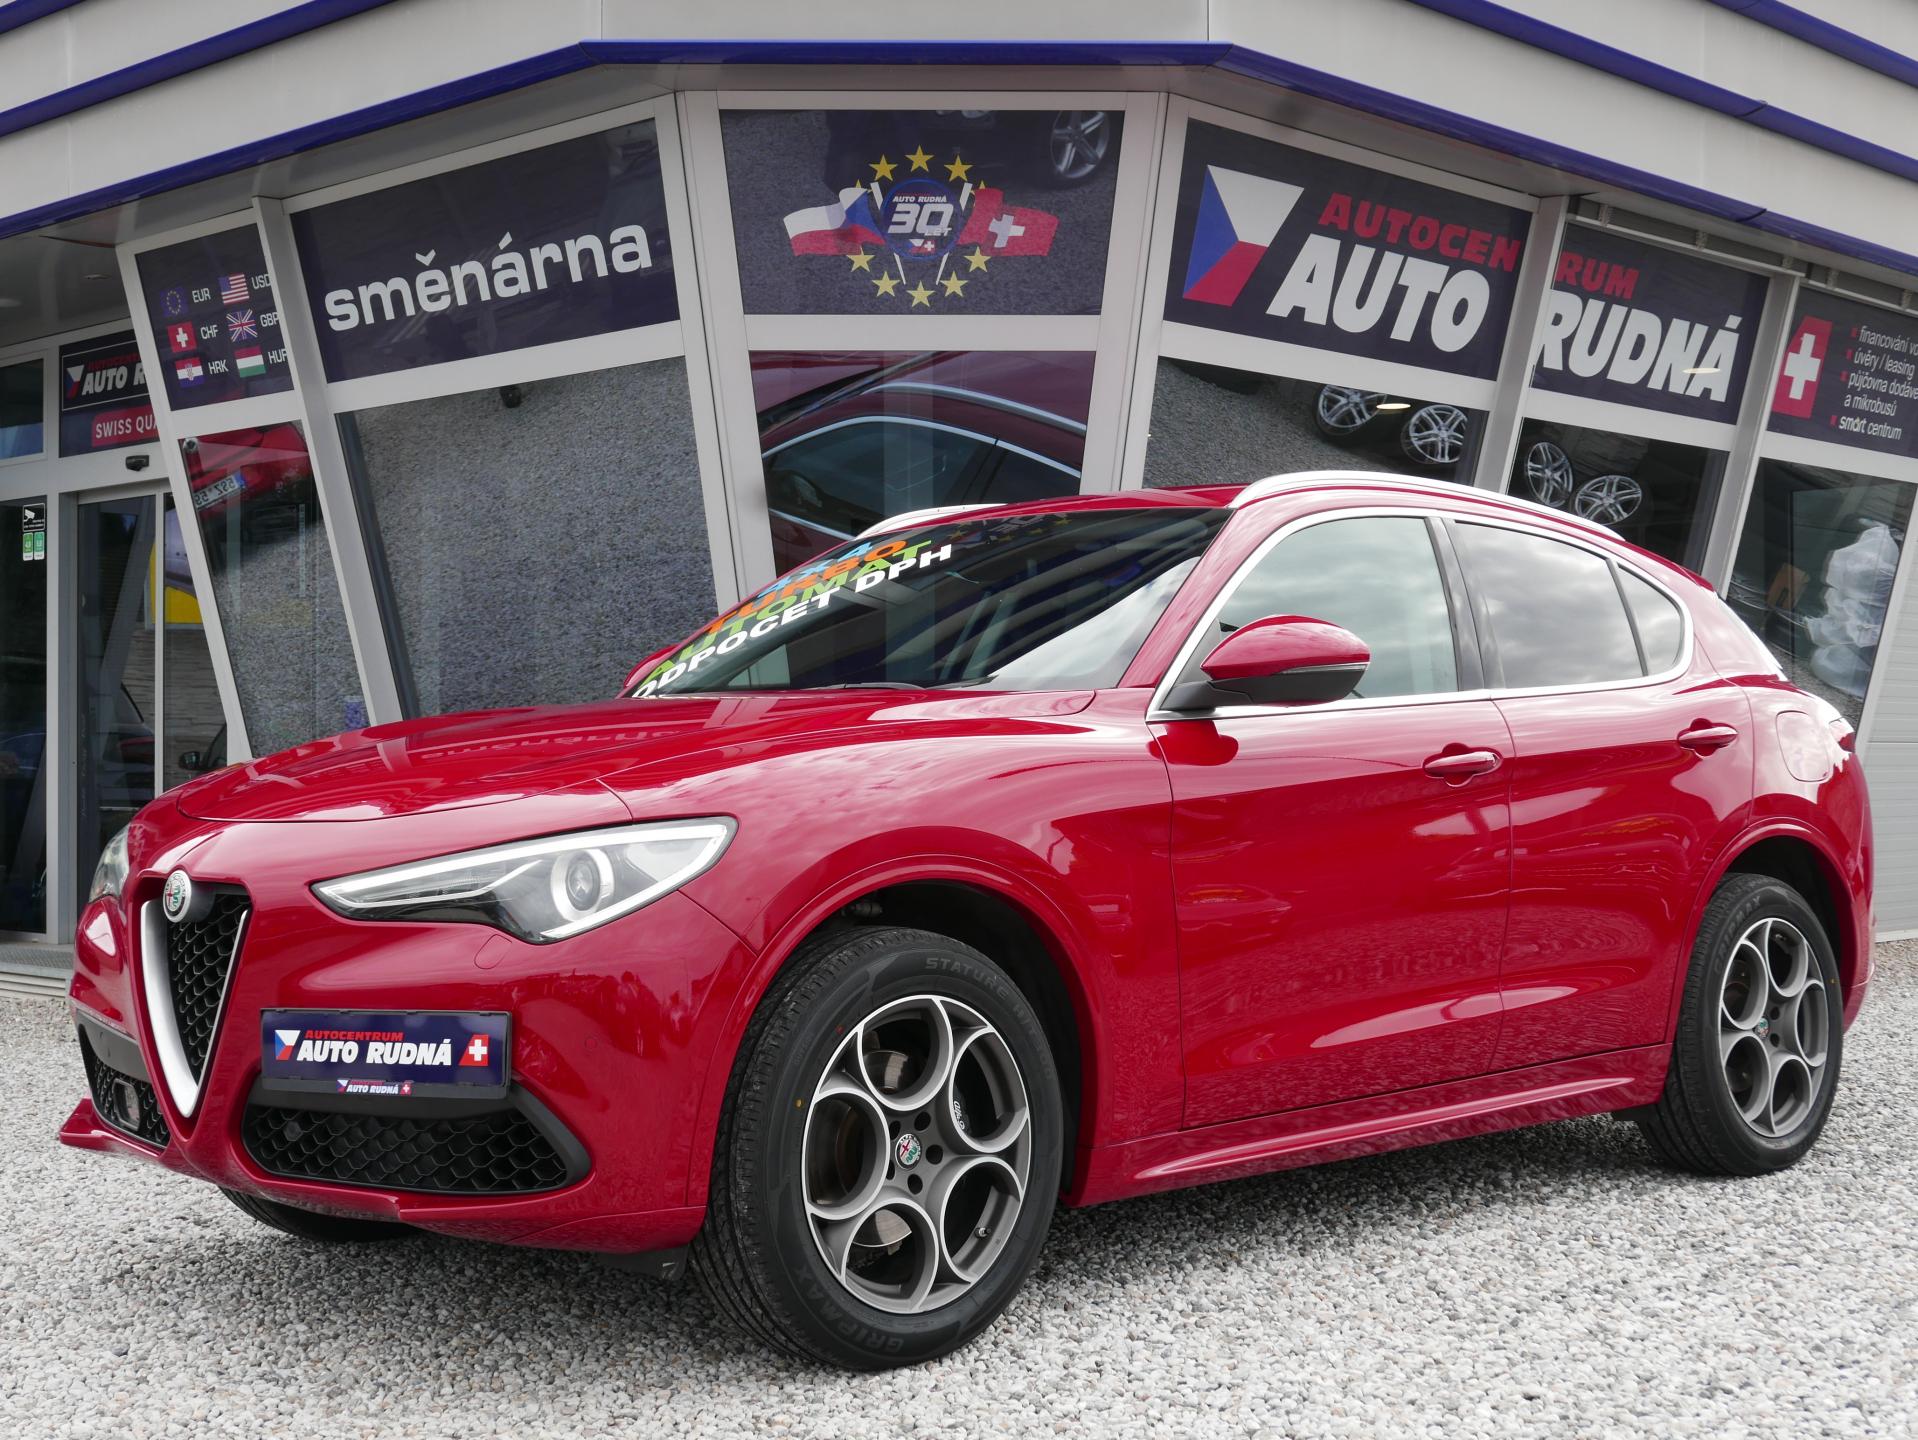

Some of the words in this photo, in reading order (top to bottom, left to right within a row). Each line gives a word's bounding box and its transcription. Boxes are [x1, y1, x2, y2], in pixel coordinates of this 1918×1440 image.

[887, 203, 954, 234] 30
[250, 273, 271, 290] USD
[324, 224, 652, 332] směnárna
[191, 287, 211, 303] EUR
[259, 311, 280, 328] GBP
[1265, 233, 1490, 353] AUTO
[1535, 288, 1743, 403] RUDNÁ
[200, 324, 219, 340] CHF
[1859, 326, 1909, 353] financování
[81, 366, 129, 395] AUTO
[208, 359, 229, 375] HRK
[1884, 354, 1916, 381] leasing
[1843, 394, 1852, 408] a
[95, 418, 132, 439] SWISS
[1867, 421, 1903, 441] centrum
[855, 543, 952, 594] DPH
[705, 540, 909, 634] TURBO
[639, 539, 933, 689] AUTOMAT
[924, 956, 1011, 1001] STATURE
[304, 1029, 404, 1042] AUTOCENTRUM
[296, 1040, 360, 1064] AUTO
[366, 1038, 452, 1066] RUDNÁ
[346, 1084, 369, 1093] AUTO
[369, 1084, 399, 1095] RUDNÁ
[792, 1264, 905, 1353] GRIPMAX
